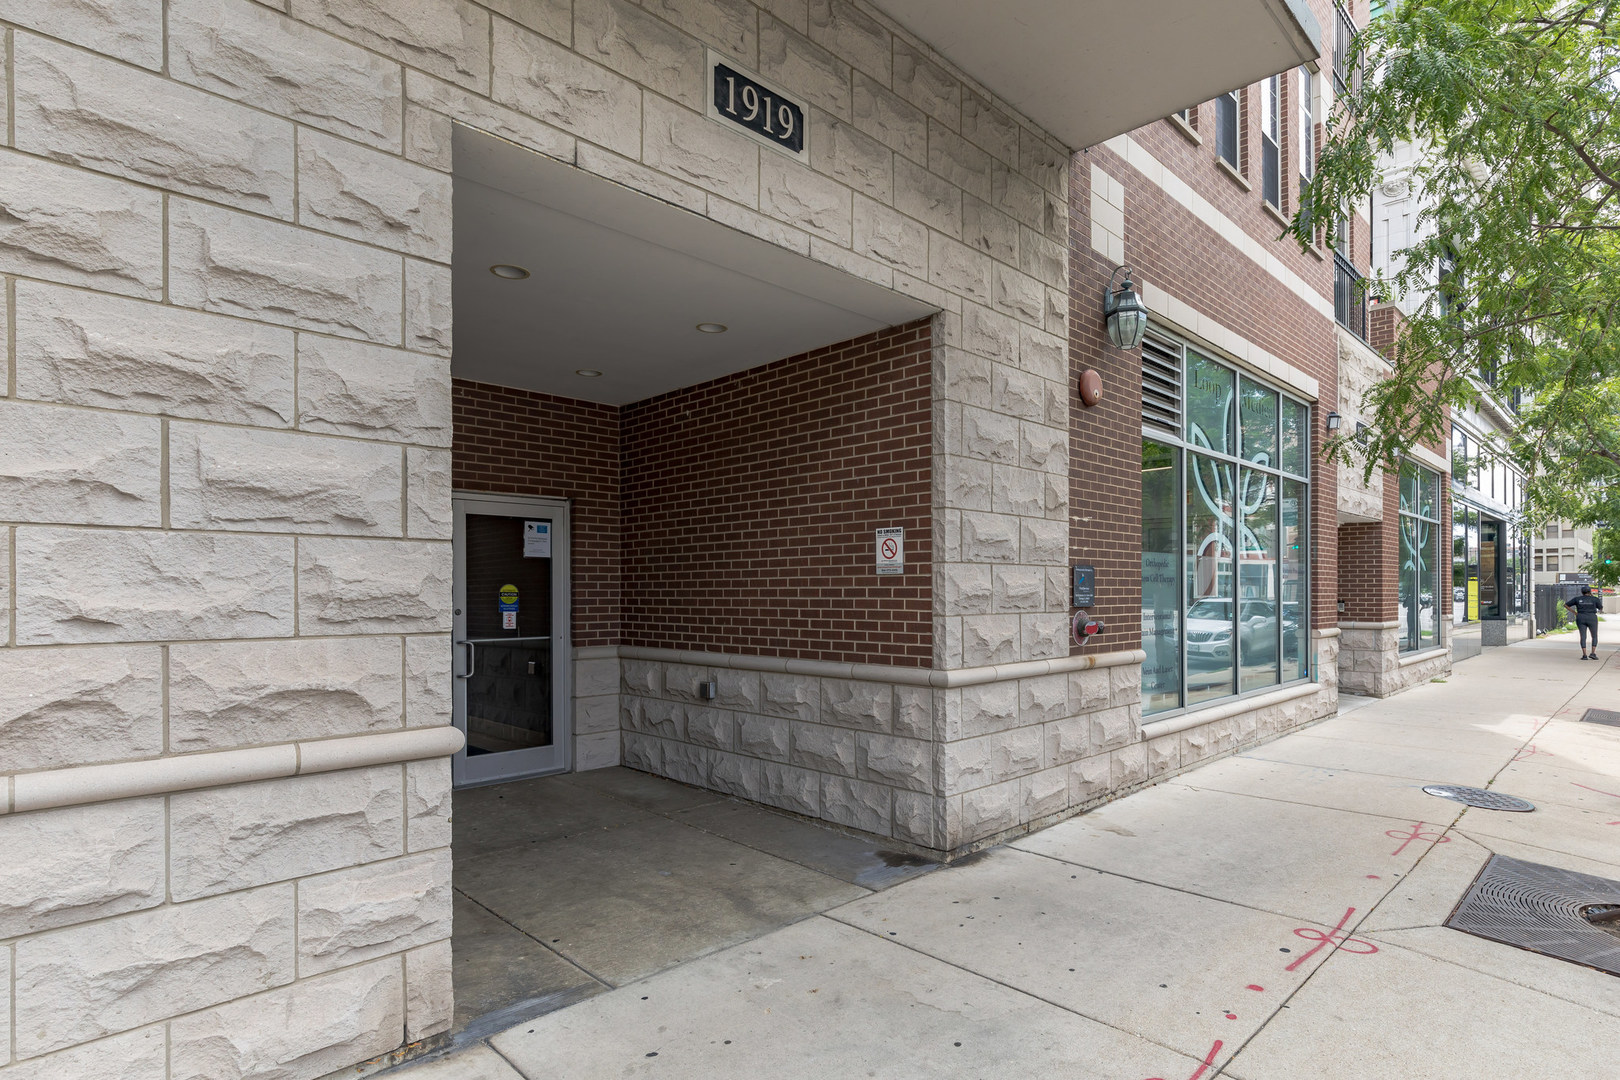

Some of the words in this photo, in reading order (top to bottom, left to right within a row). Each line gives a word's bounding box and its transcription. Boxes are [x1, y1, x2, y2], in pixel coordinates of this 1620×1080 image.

[725, 77, 794, 139] 1919
[1195, 369, 1222, 404] Loop
[1146, 558, 1169, 570] Orthopedic
[1150, 573, 1159, 582] Cell
[1159, 574, 1175, 586] Therapy
